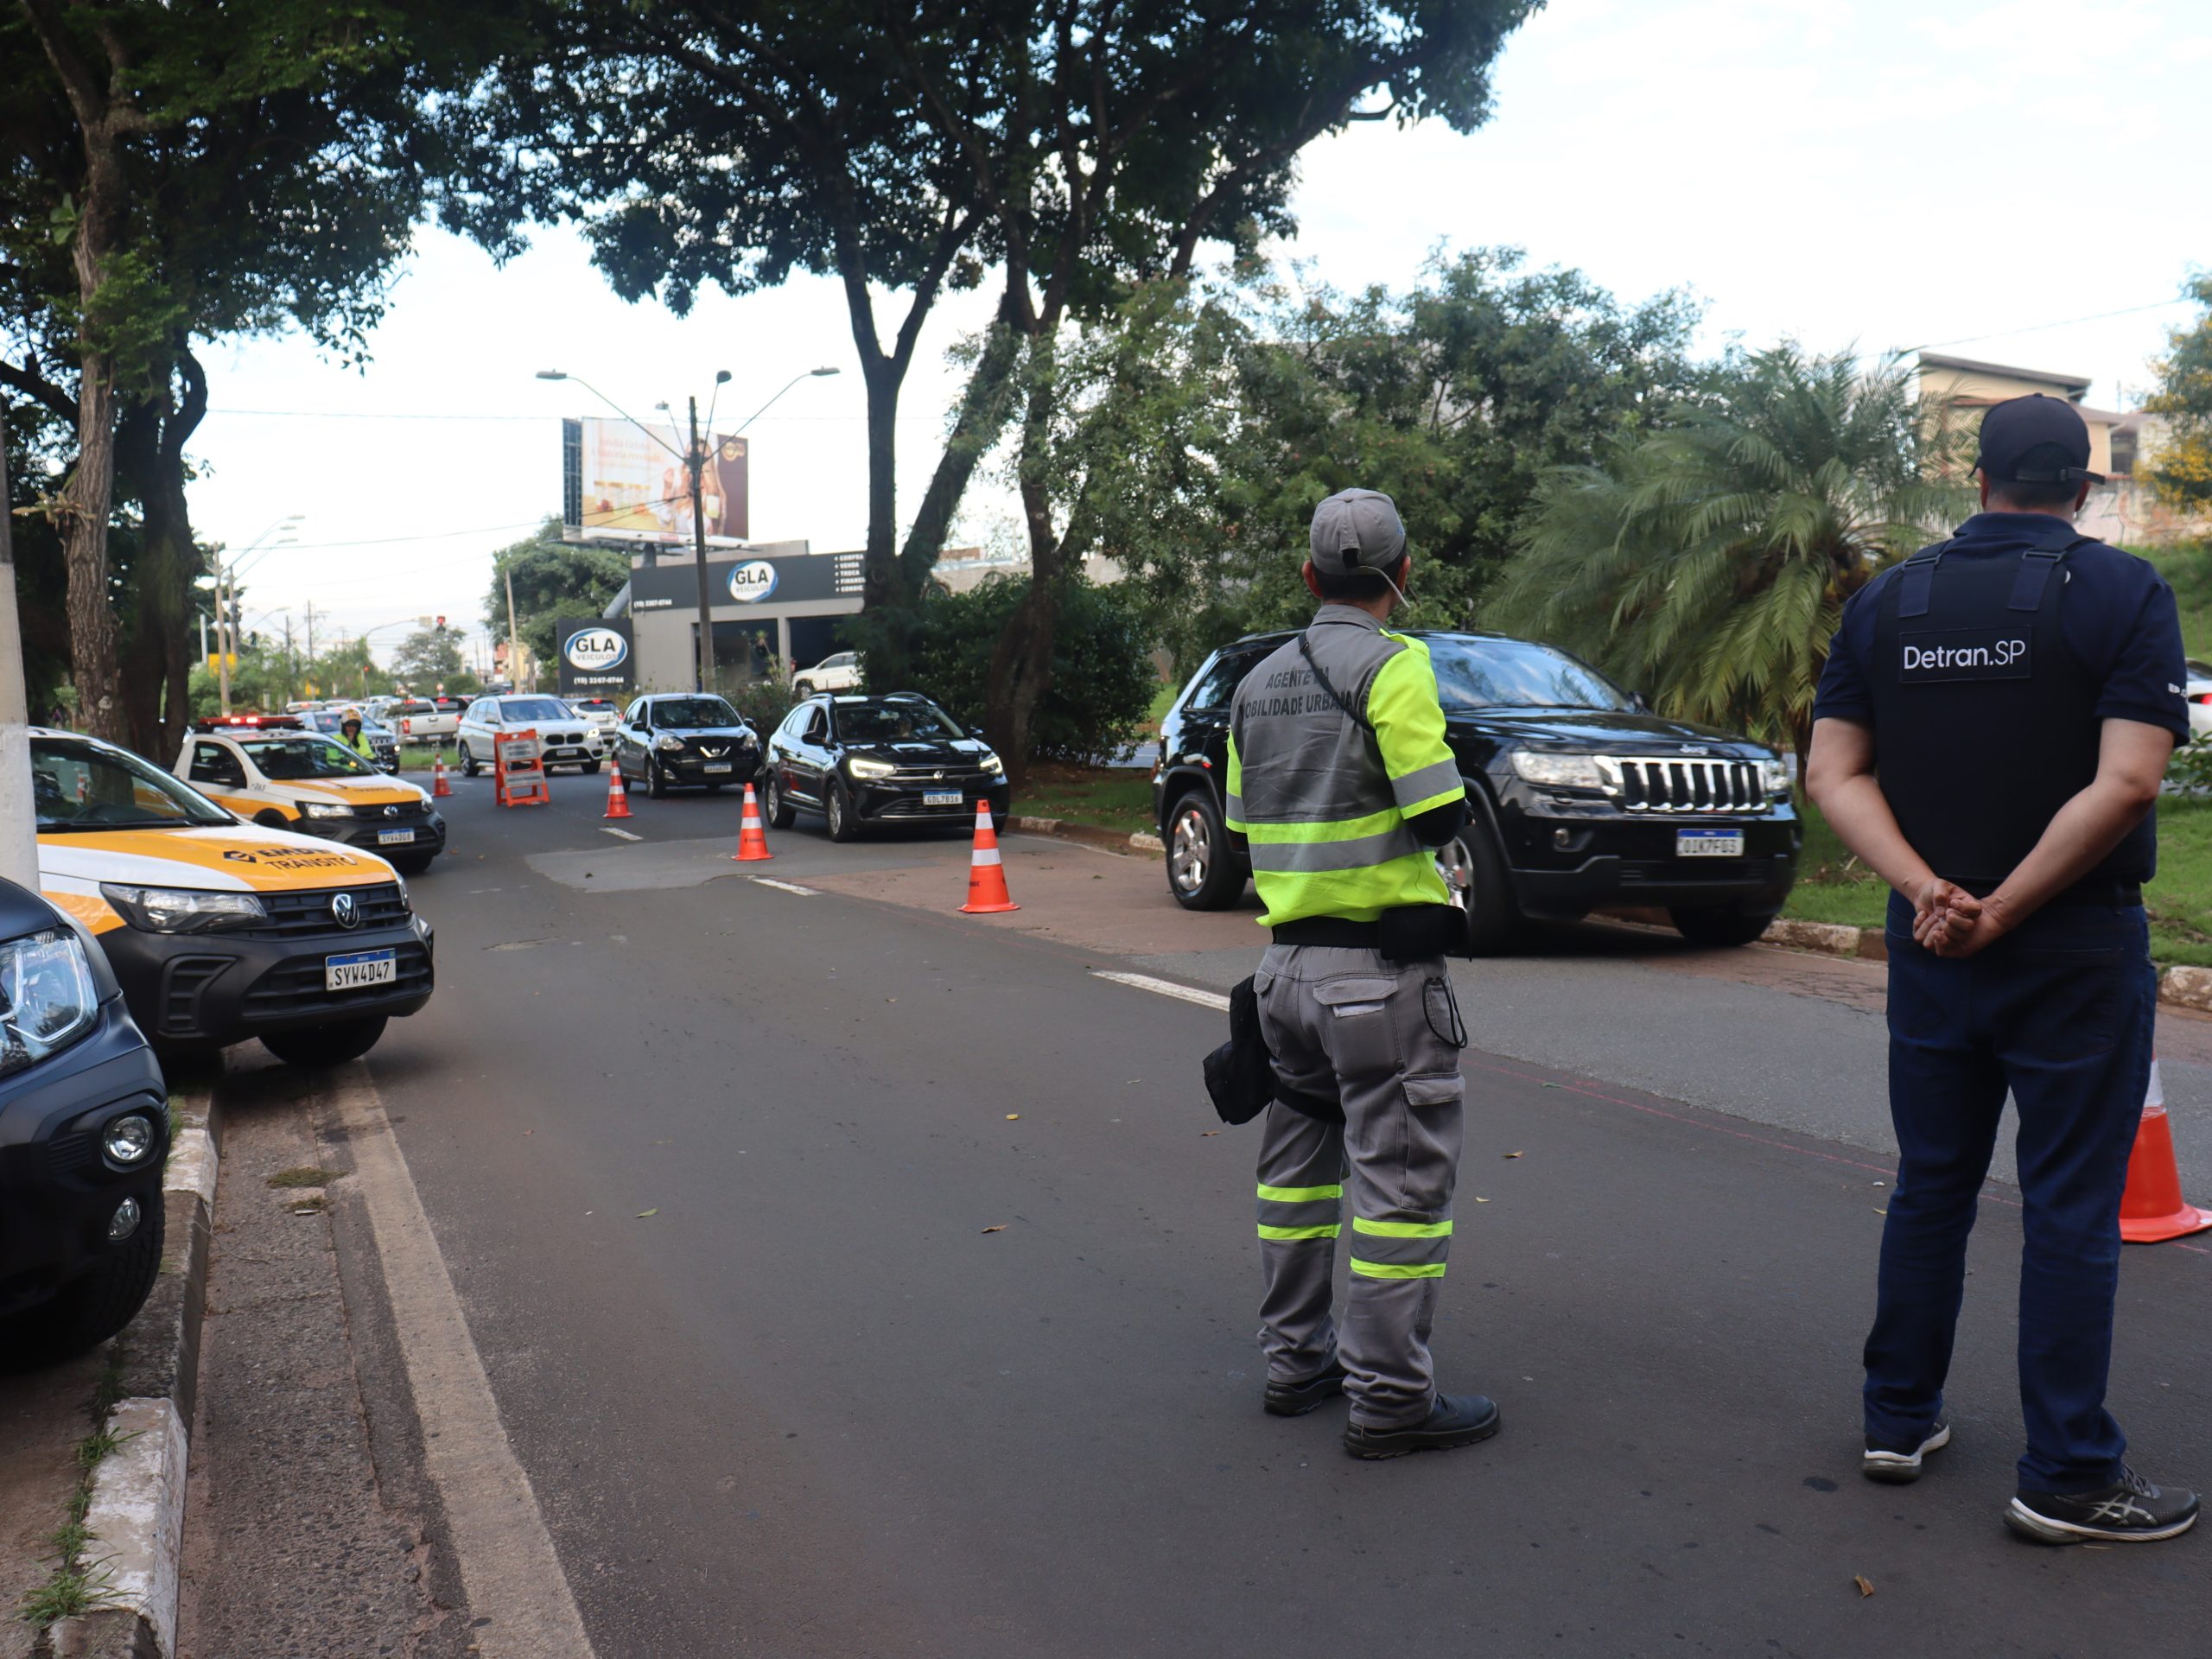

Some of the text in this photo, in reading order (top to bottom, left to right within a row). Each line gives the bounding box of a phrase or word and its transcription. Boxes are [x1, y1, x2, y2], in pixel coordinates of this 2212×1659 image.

[735, 569, 769, 585] GLA
[575, 638, 615, 652] GLA
[1904, 639, 2026, 670] Detran.SP
[1265, 669, 1313, 690] AGENTE
[1679, 744, 1709, 756] Jeep
[334, 962, 390, 986] SYW4D47
